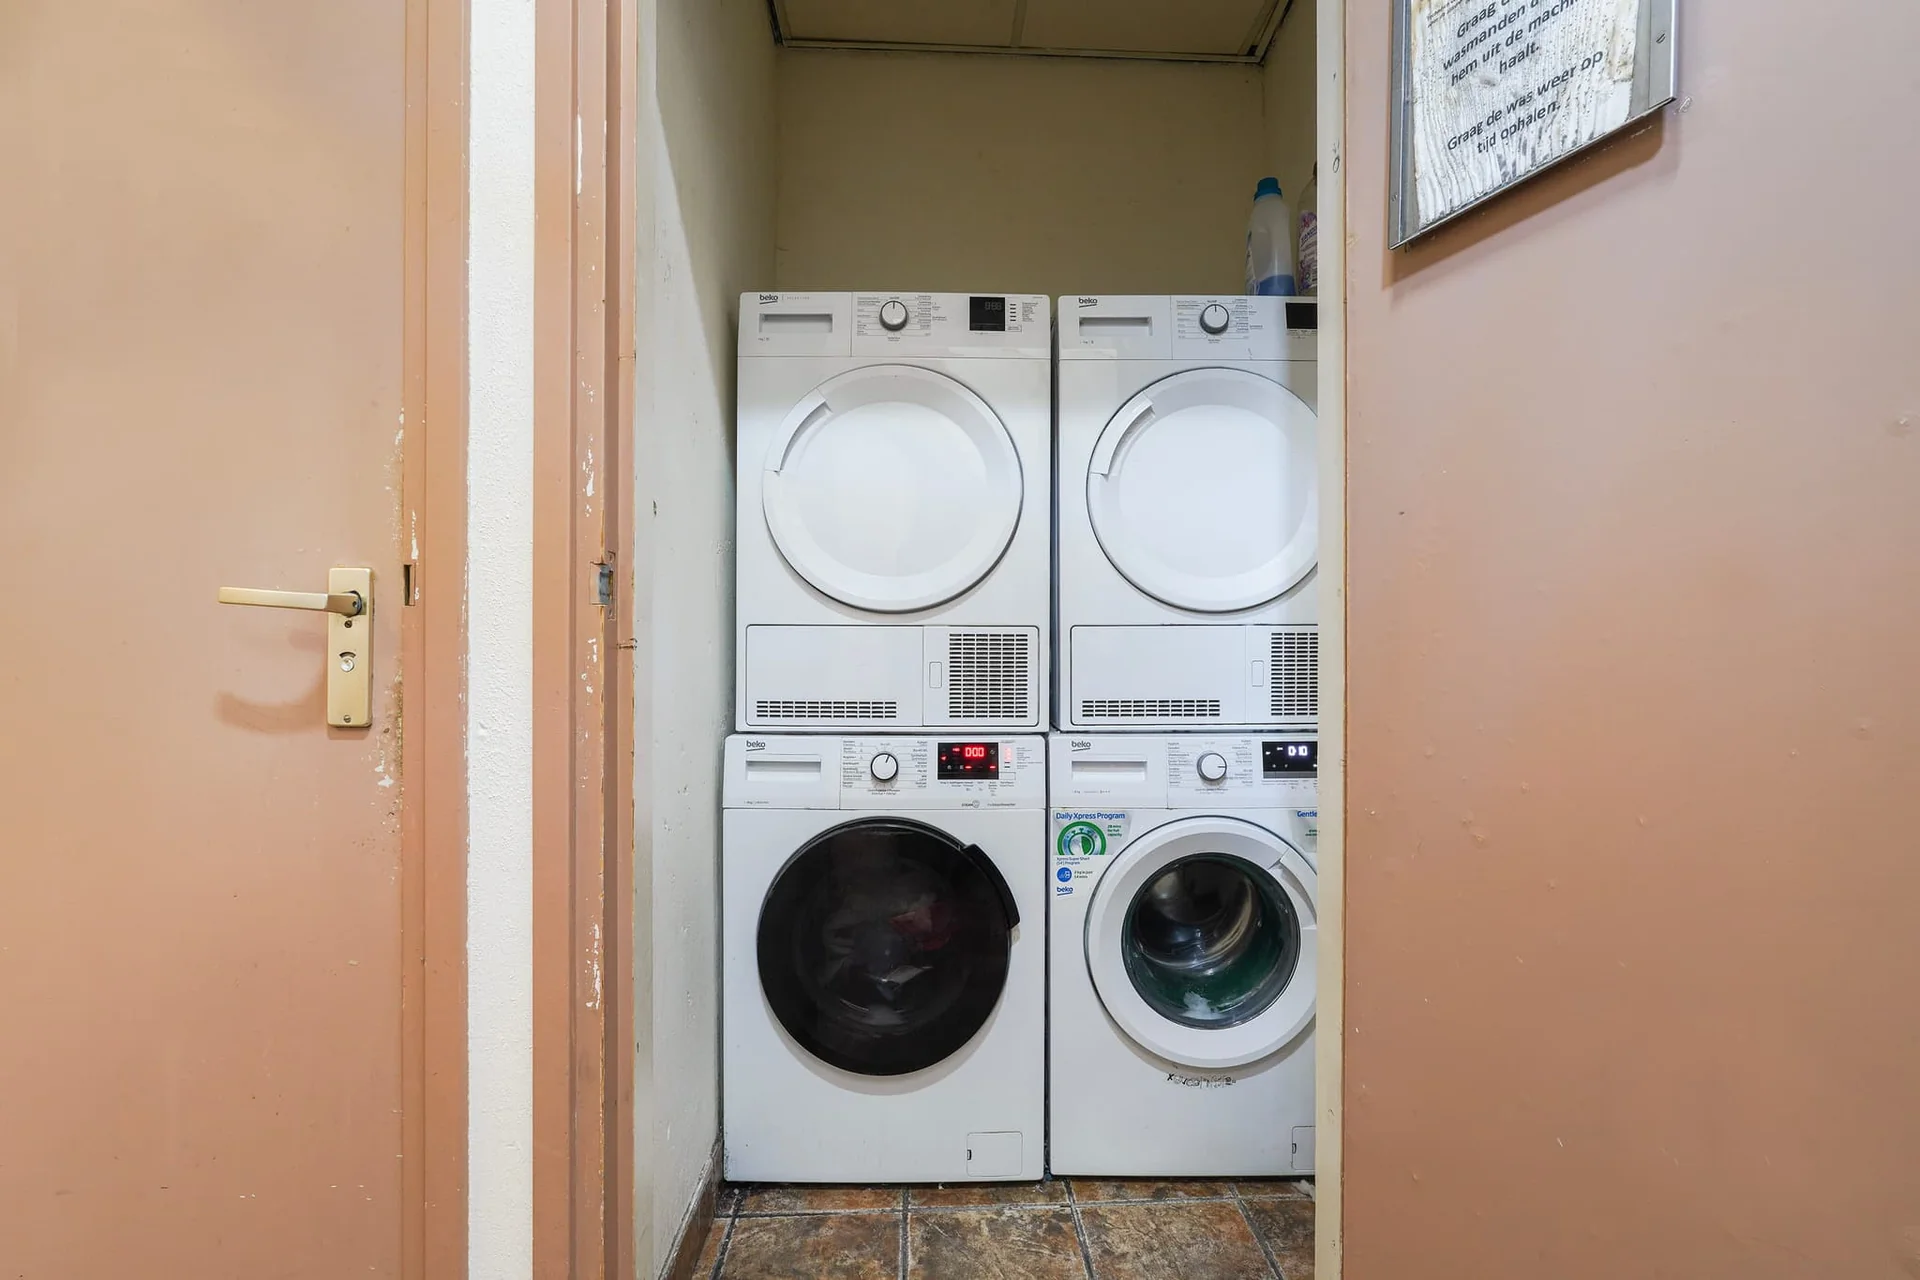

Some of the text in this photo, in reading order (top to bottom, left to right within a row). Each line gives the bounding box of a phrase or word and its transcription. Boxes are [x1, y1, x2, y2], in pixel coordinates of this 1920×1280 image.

[1457, 1, 1496, 38] Graag
[1443, 5, 1526, 71] wasmanden
[1451, 58, 1478, 86] hem
[1482, 43, 1501, 63] uit
[1505, 28, 1524, 48] de
[1500, 42, 1540, 74] haalt.
[1447, 51, 1604, 151] Graag de was weer op
[1477, 100, 1561, 153] tijd ophalen.
[759, 294, 779, 303] beko
[1079, 297, 1098, 306] beko
[746, 740, 766, 750] beko
[1071, 740, 1092, 750] beko
[1056, 886, 1074, 894] beko
